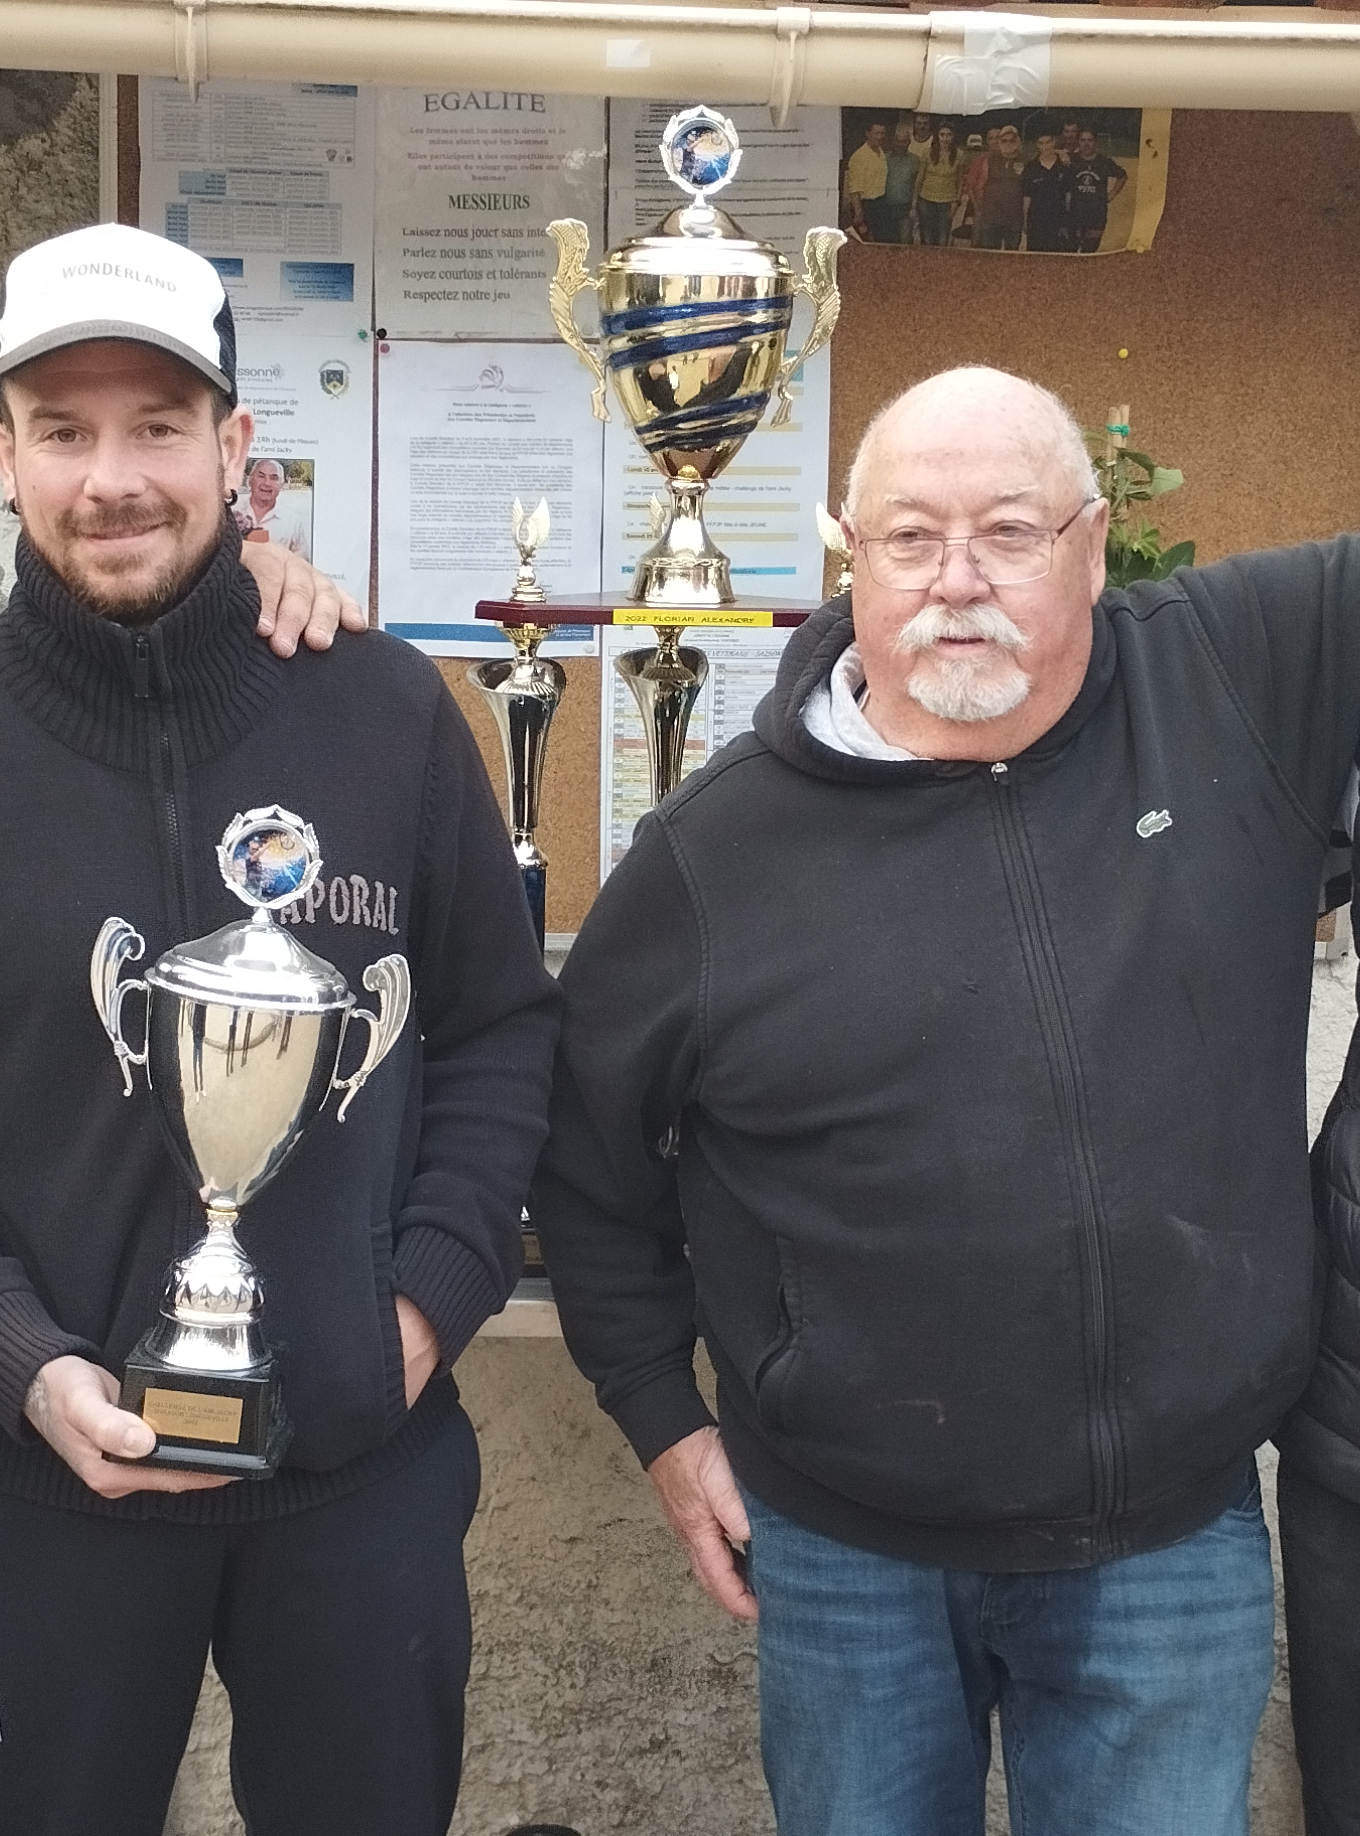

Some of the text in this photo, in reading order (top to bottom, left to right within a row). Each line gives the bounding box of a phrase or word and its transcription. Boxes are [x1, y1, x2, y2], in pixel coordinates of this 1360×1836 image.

[423, 91, 546, 114] EGALITE
[448, 193, 531, 211] MESSIEURS
[402, 227, 441, 238] Laissez
[443, 228, 468, 238] nous
[470, 225, 499, 241] jouer
[501, 228, 523, 238] sans
[402, 247, 546, 261] Parlez nous sans vulgarité
[62, 262, 177, 293] WONDERLAND
[402, 267, 547, 280] Soyez courtois et tolérants
[403, 289, 510, 303] Respectez notre jeu
[236, 367, 280, 377] ssonne
[253, 408, 295, 418] Longueville
[653, 615, 695, 623] FLORIAN
